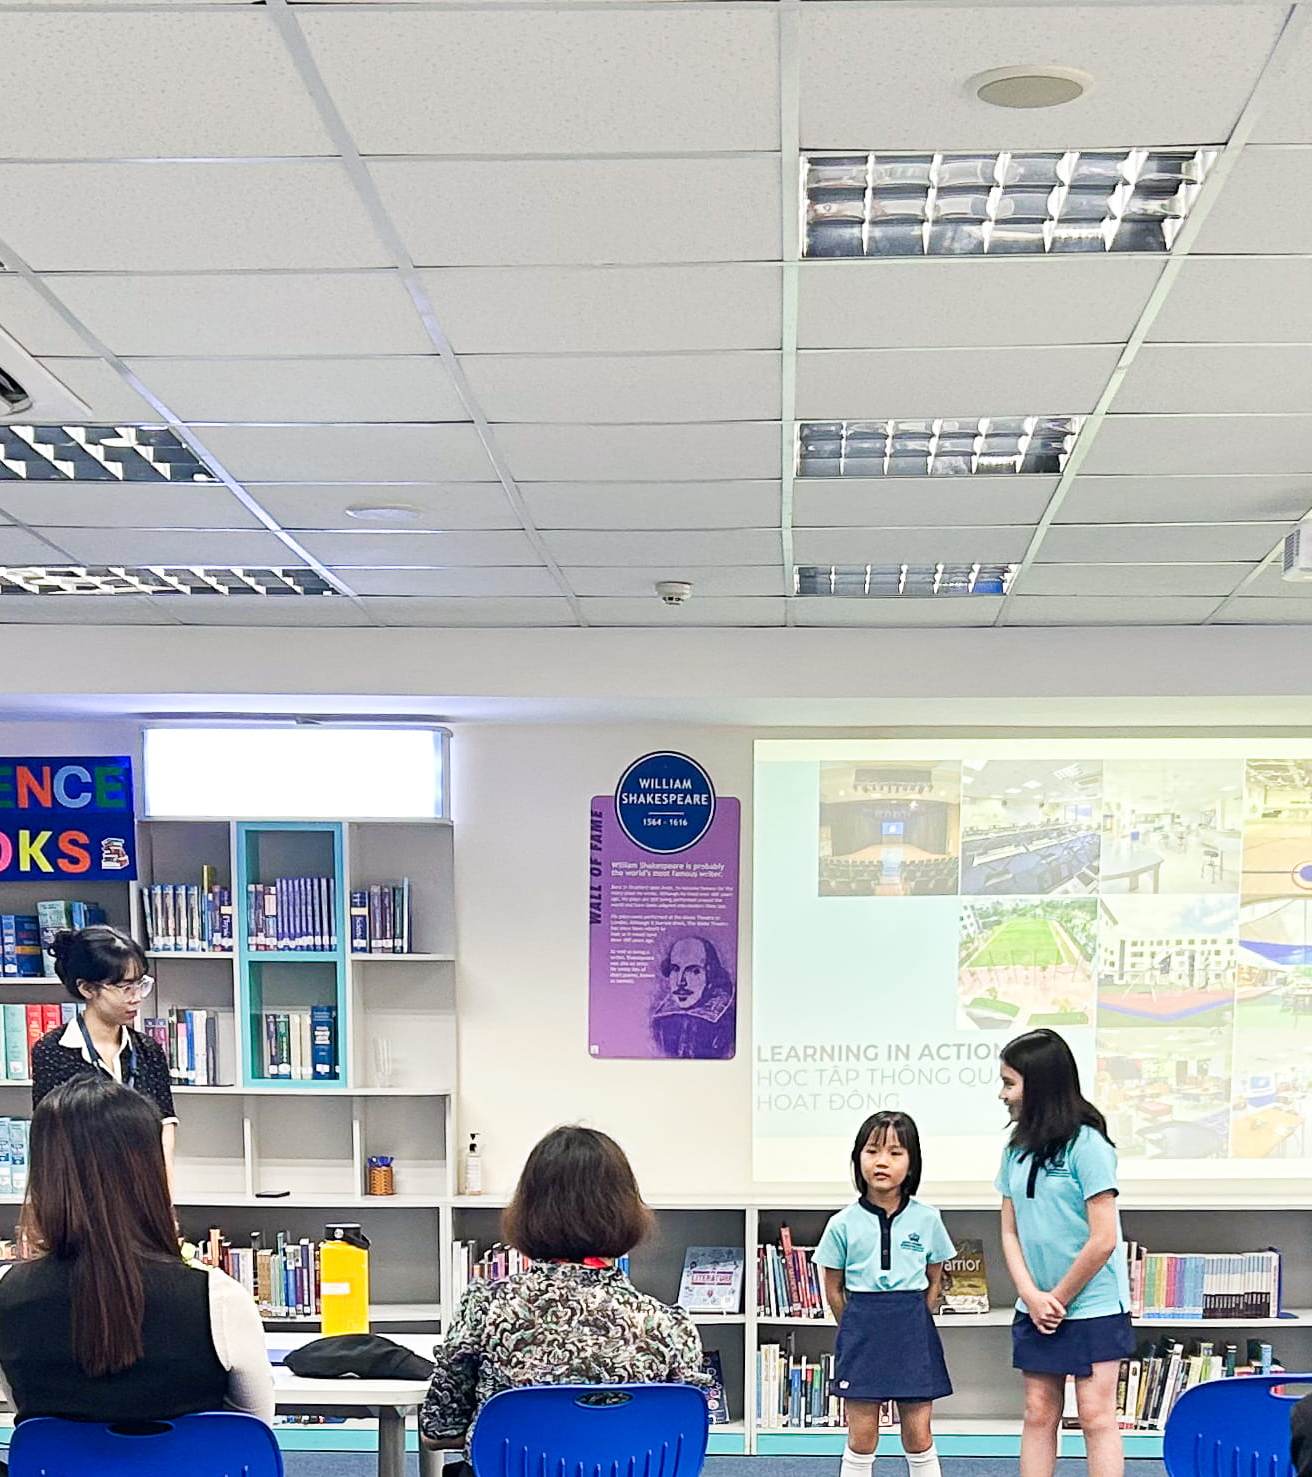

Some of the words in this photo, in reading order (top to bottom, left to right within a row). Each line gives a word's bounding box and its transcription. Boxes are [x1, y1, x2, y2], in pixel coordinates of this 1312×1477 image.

[639, 778, 692, 790] WILLIAM
[622, 793, 709, 806] SHAKESPEARE
[591, 810, 603, 851] FAME
[643, 818, 662, 827] 1564
[669, 818, 688, 827] 1616
[590, 856, 602, 877] OF
[640, 862, 684, 871] Shakespeare
[694, 862, 724, 871] probably
[590, 885, 602, 925] WALL
[757, 1044, 879, 1062] LEARNING
[887, 1044, 911, 1062] IN
[867, 1064, 951, 1086] THÔNG
[959, 1067, 1000, 1087] QU
